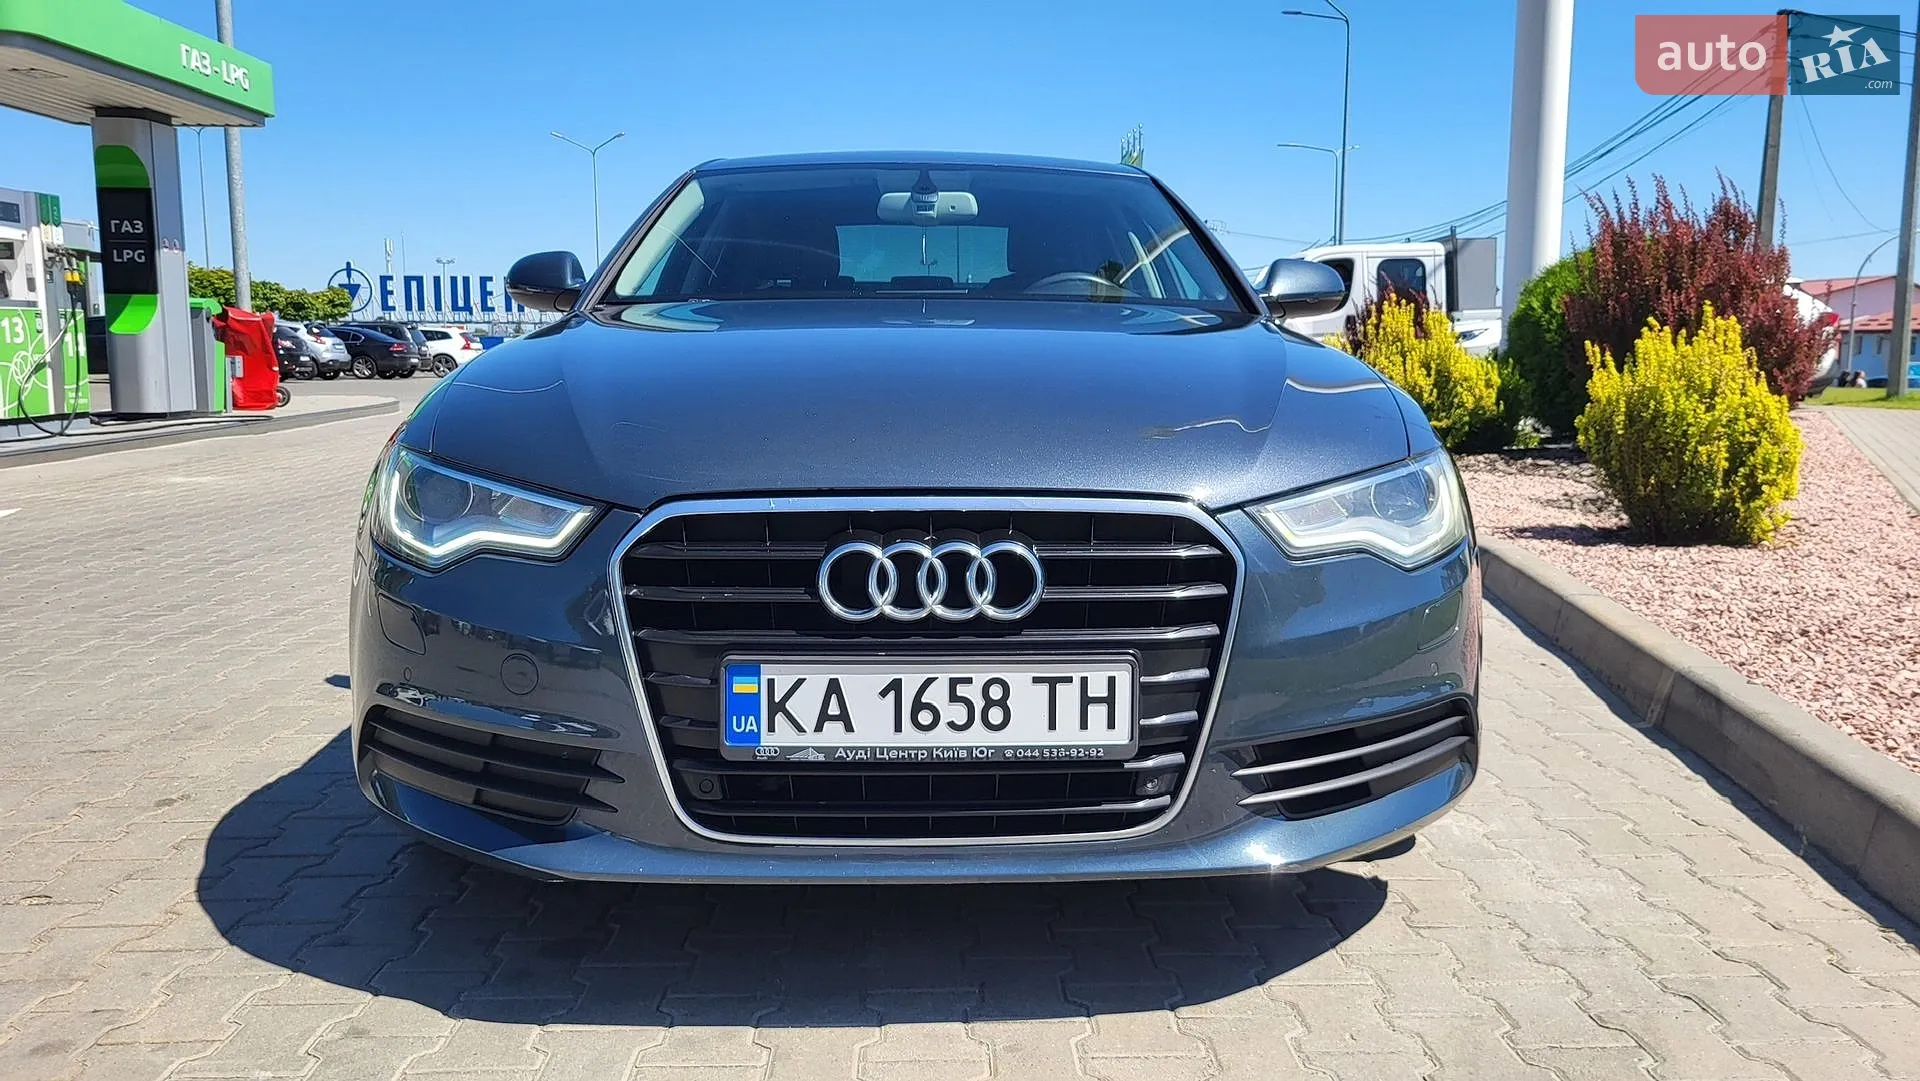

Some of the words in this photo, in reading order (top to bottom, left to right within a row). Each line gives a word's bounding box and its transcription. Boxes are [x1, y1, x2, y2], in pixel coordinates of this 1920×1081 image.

[110, 220, 144, 233] ГАЗ
[112, 249, 146, 263] LPG
[1, 316, 25, 344] 13
[878, 676, 1012, 732] 1658
[732, 715, 758, 732] UA
[834, 747, 871, 761] Ауді
[876, 748, 929, 761] Центр
[933, 747, 967, 758] Київ
[972, 746, 996, 758] Юг
[1016, 748, 1040, 757] 044
